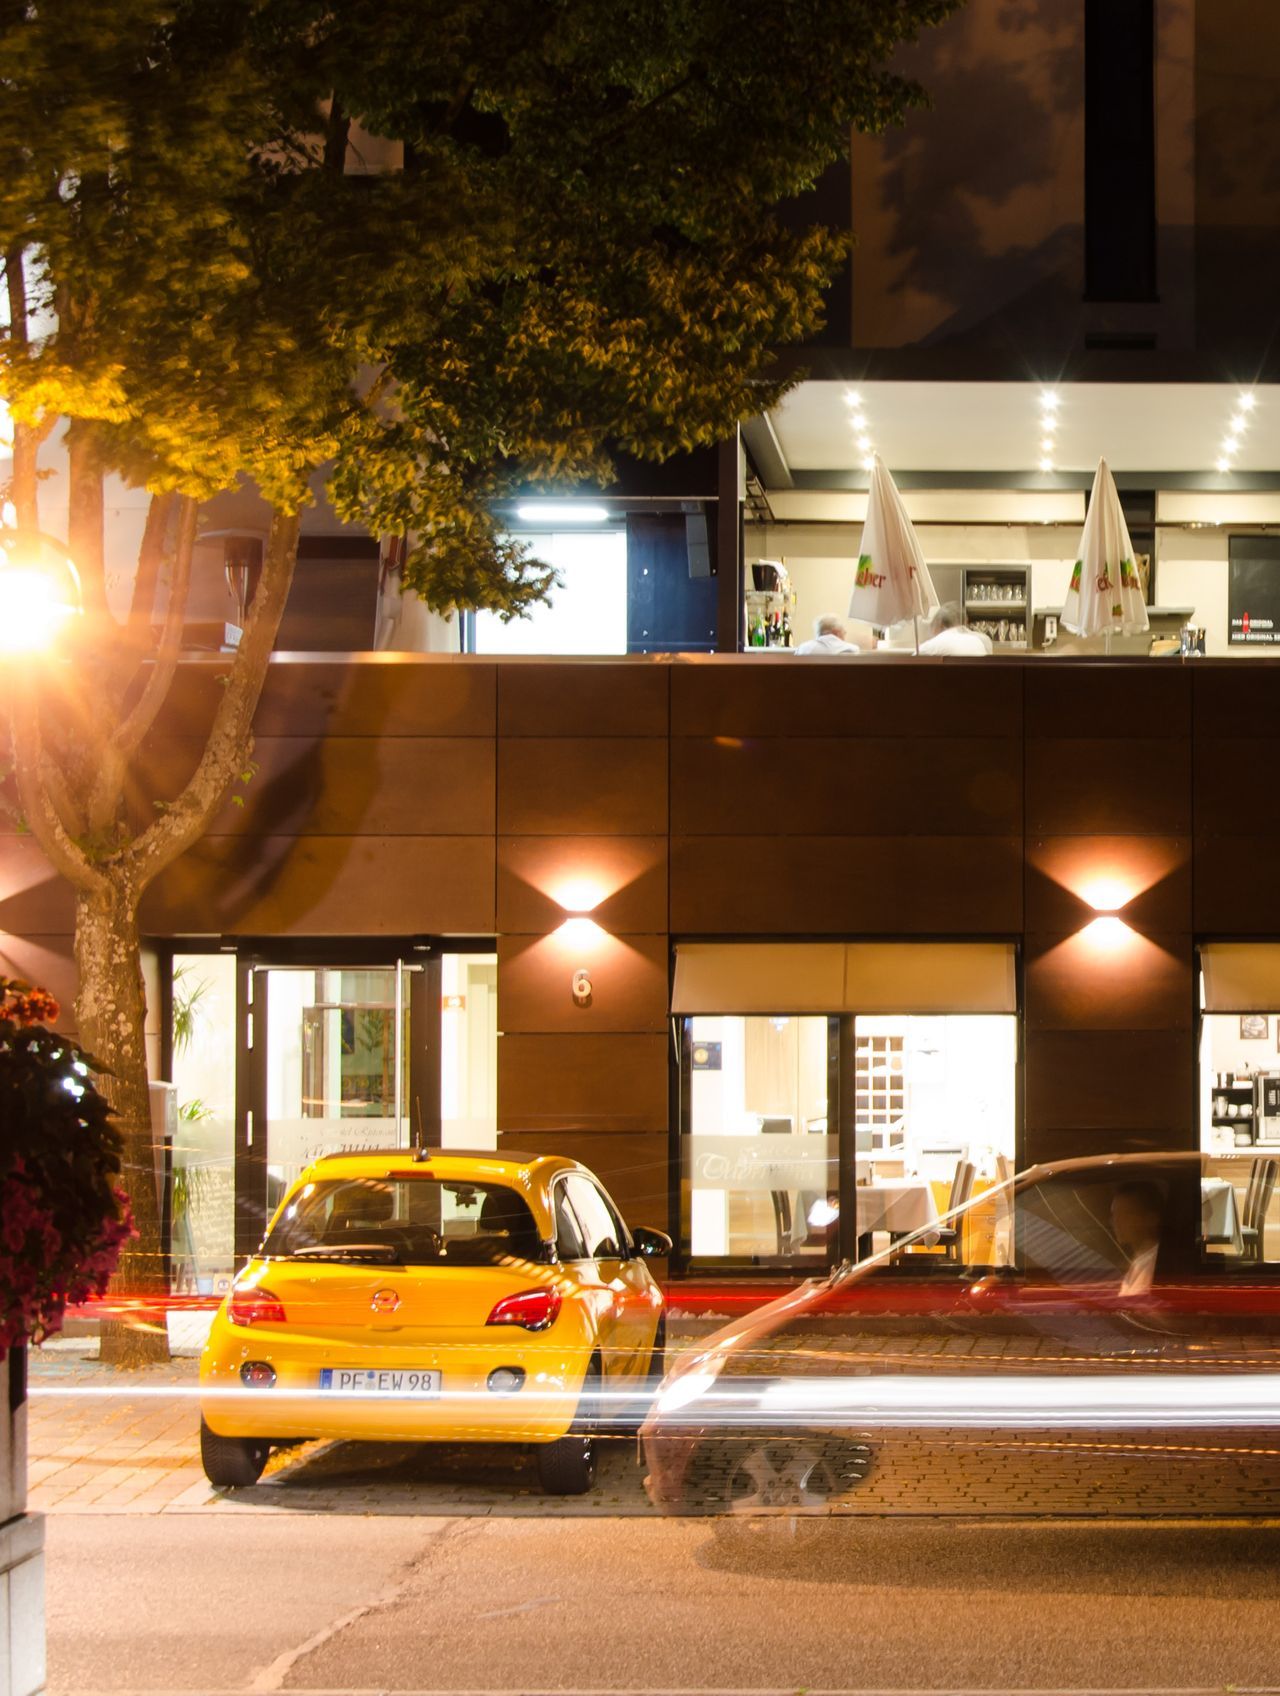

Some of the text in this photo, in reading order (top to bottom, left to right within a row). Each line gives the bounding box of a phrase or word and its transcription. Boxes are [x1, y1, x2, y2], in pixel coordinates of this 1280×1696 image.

[572, 969, 592, 997] 6
[340, 1372, 432, 1392] PF EW 98
